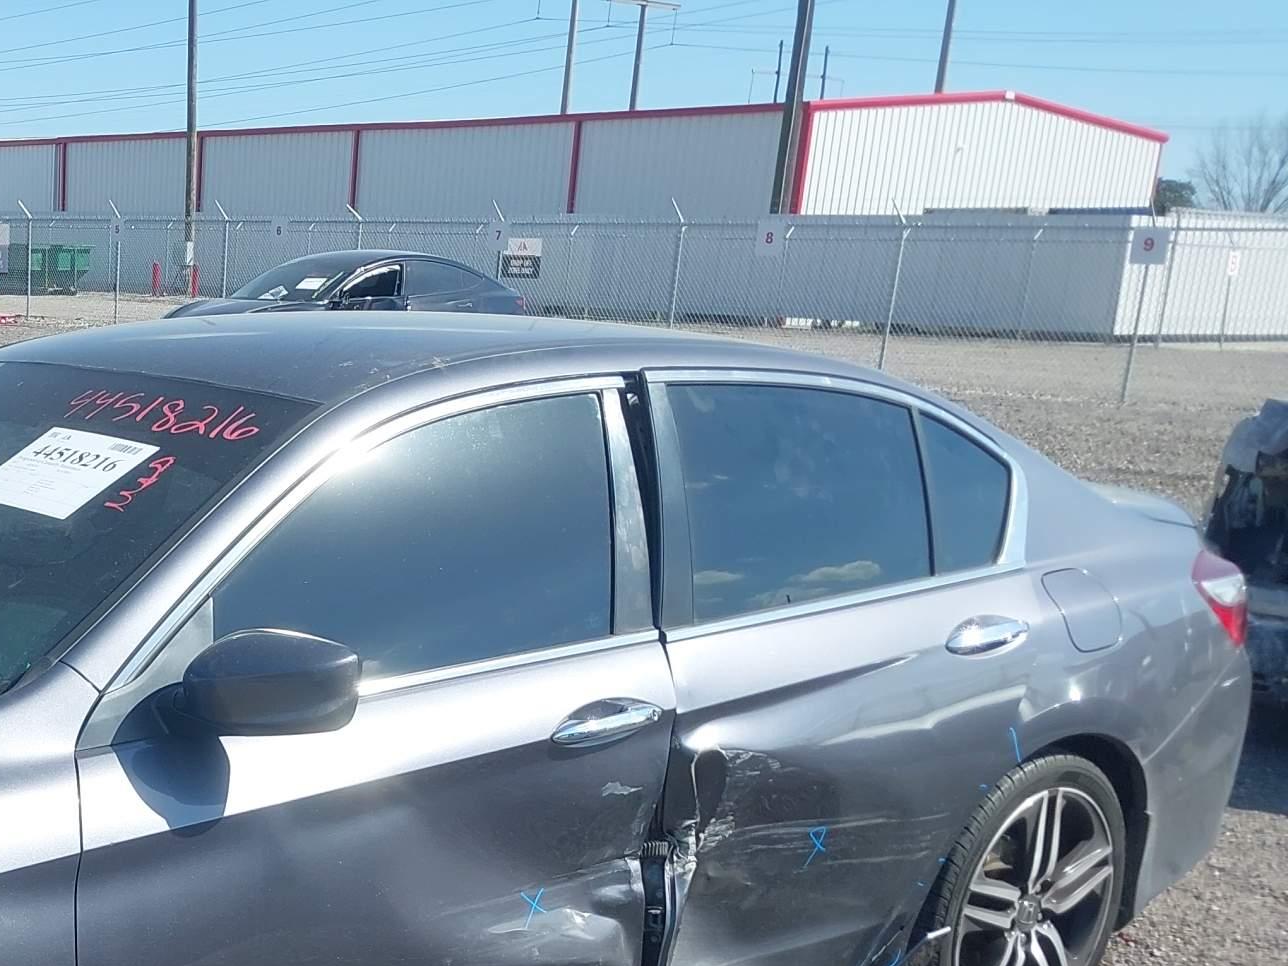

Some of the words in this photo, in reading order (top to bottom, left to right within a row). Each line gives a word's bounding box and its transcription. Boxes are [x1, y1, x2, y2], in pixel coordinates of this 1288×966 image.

[276, 225, 282, 236] 6
[495, 230, 502, 240] 7
[765, 231, 774, 244] 8
[1143, 237, 1155, 252] 9
[64, 390, 260, 440] 44518216
[32, 444, 128, 473] 44518216
